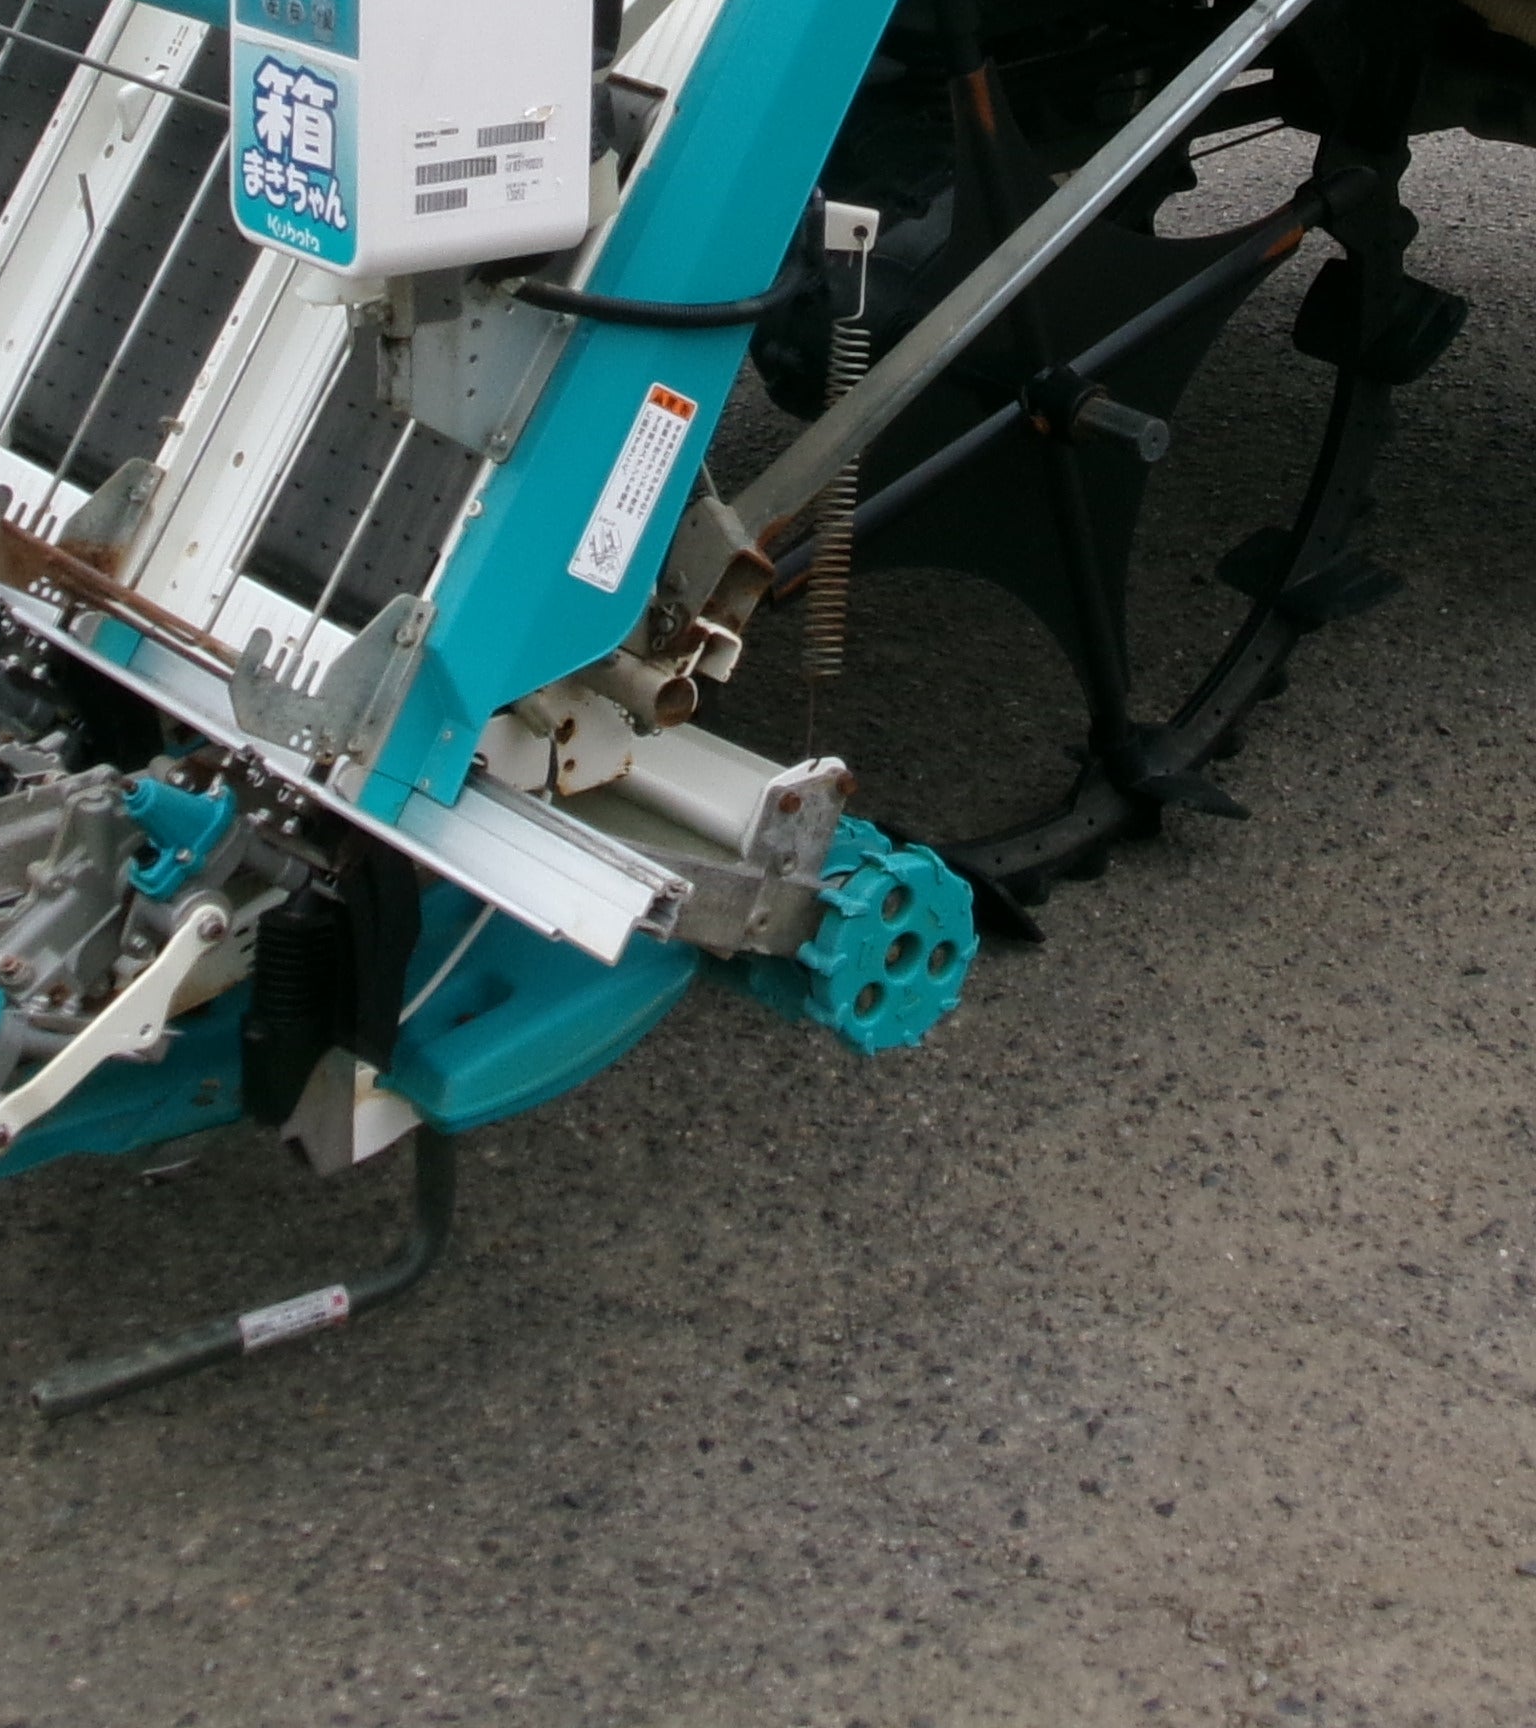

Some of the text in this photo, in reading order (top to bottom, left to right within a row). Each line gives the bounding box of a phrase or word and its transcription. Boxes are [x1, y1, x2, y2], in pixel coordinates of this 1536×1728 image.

[256, 60, 336, 171] 箱
[242, 148, 348, 230] まきちゃん
[267, 213, 321, 253] Kubota
